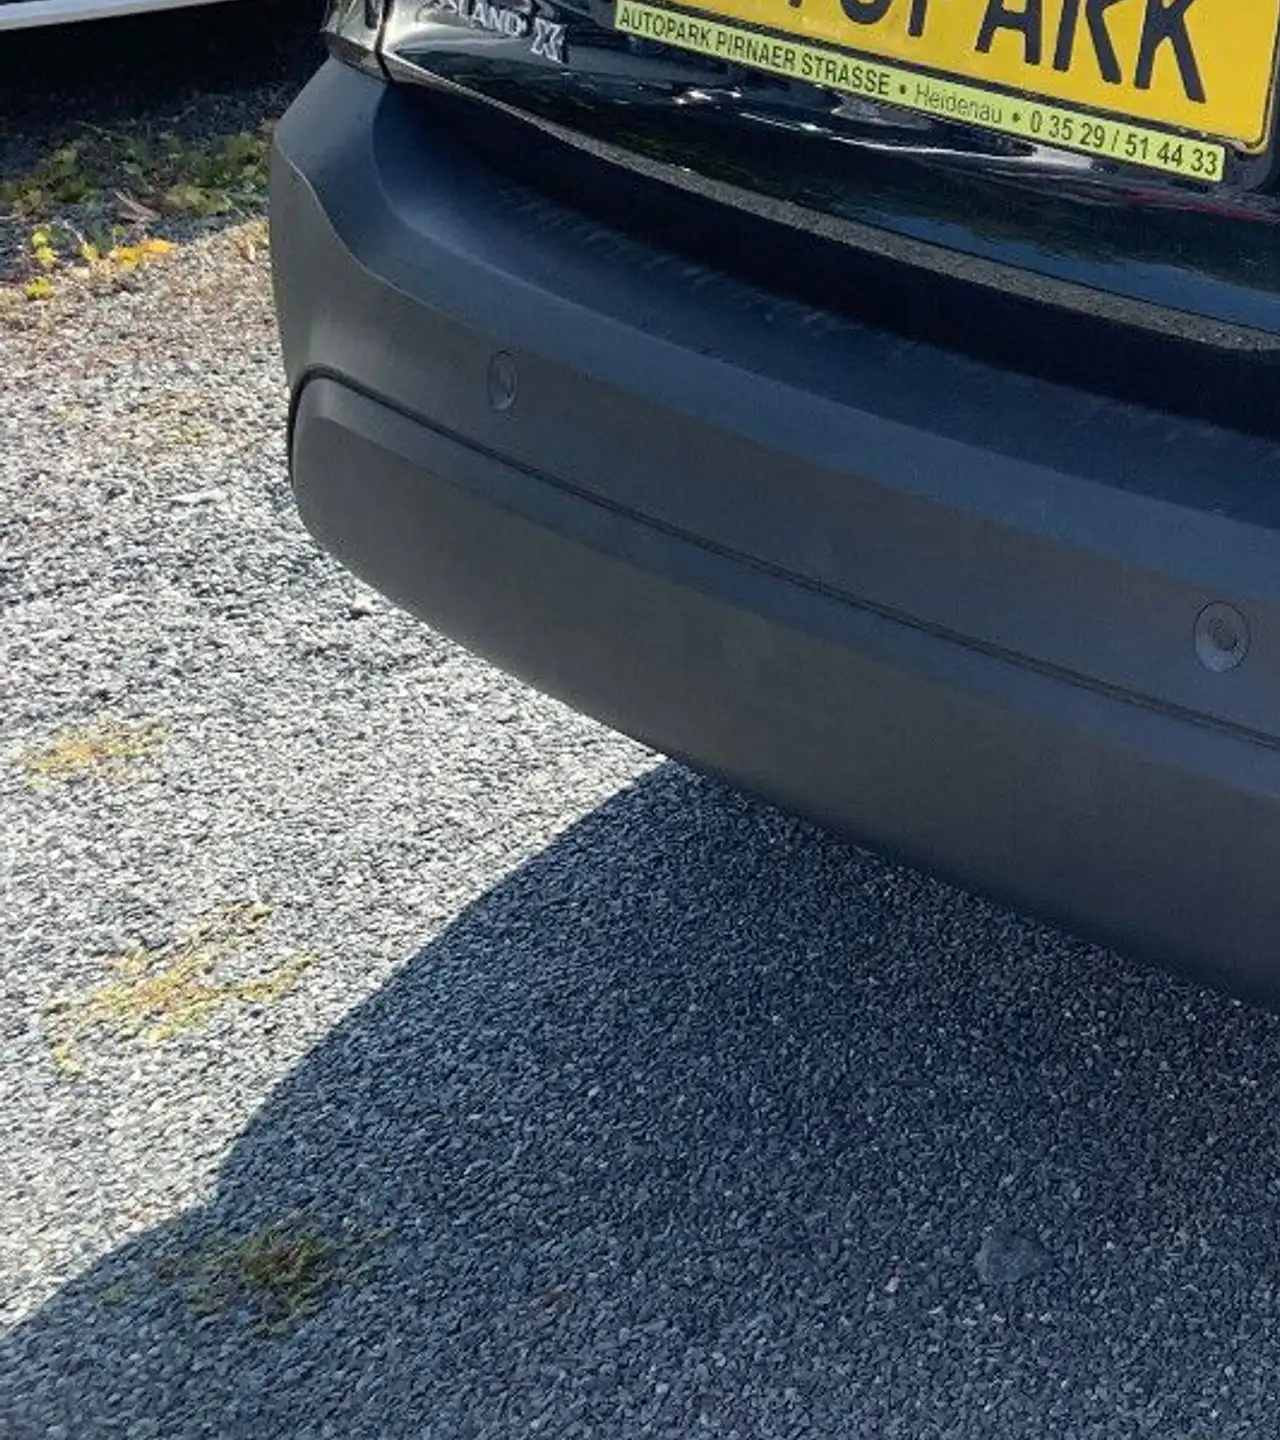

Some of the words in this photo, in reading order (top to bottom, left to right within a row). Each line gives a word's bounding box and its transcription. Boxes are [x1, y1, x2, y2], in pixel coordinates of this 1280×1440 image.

[618, 6, 712, 47] AUTOPARK
[715, 30, 797, 74] PIRNAER
[800, 51, 891, 95] STRASSE
[914, 82, 1003, 123] Heidenau
[1029, 110, 1044, 133] 0
[1048, 114, 1074, 142] 35
[1079, 121, 1106, 148] 29
[1109, 128, 1119, 153] /
[1124, 135, 1150, 160] 51
[1156, 140, 1183, 168] 44
[1189, 147, 1218, 177] 33
